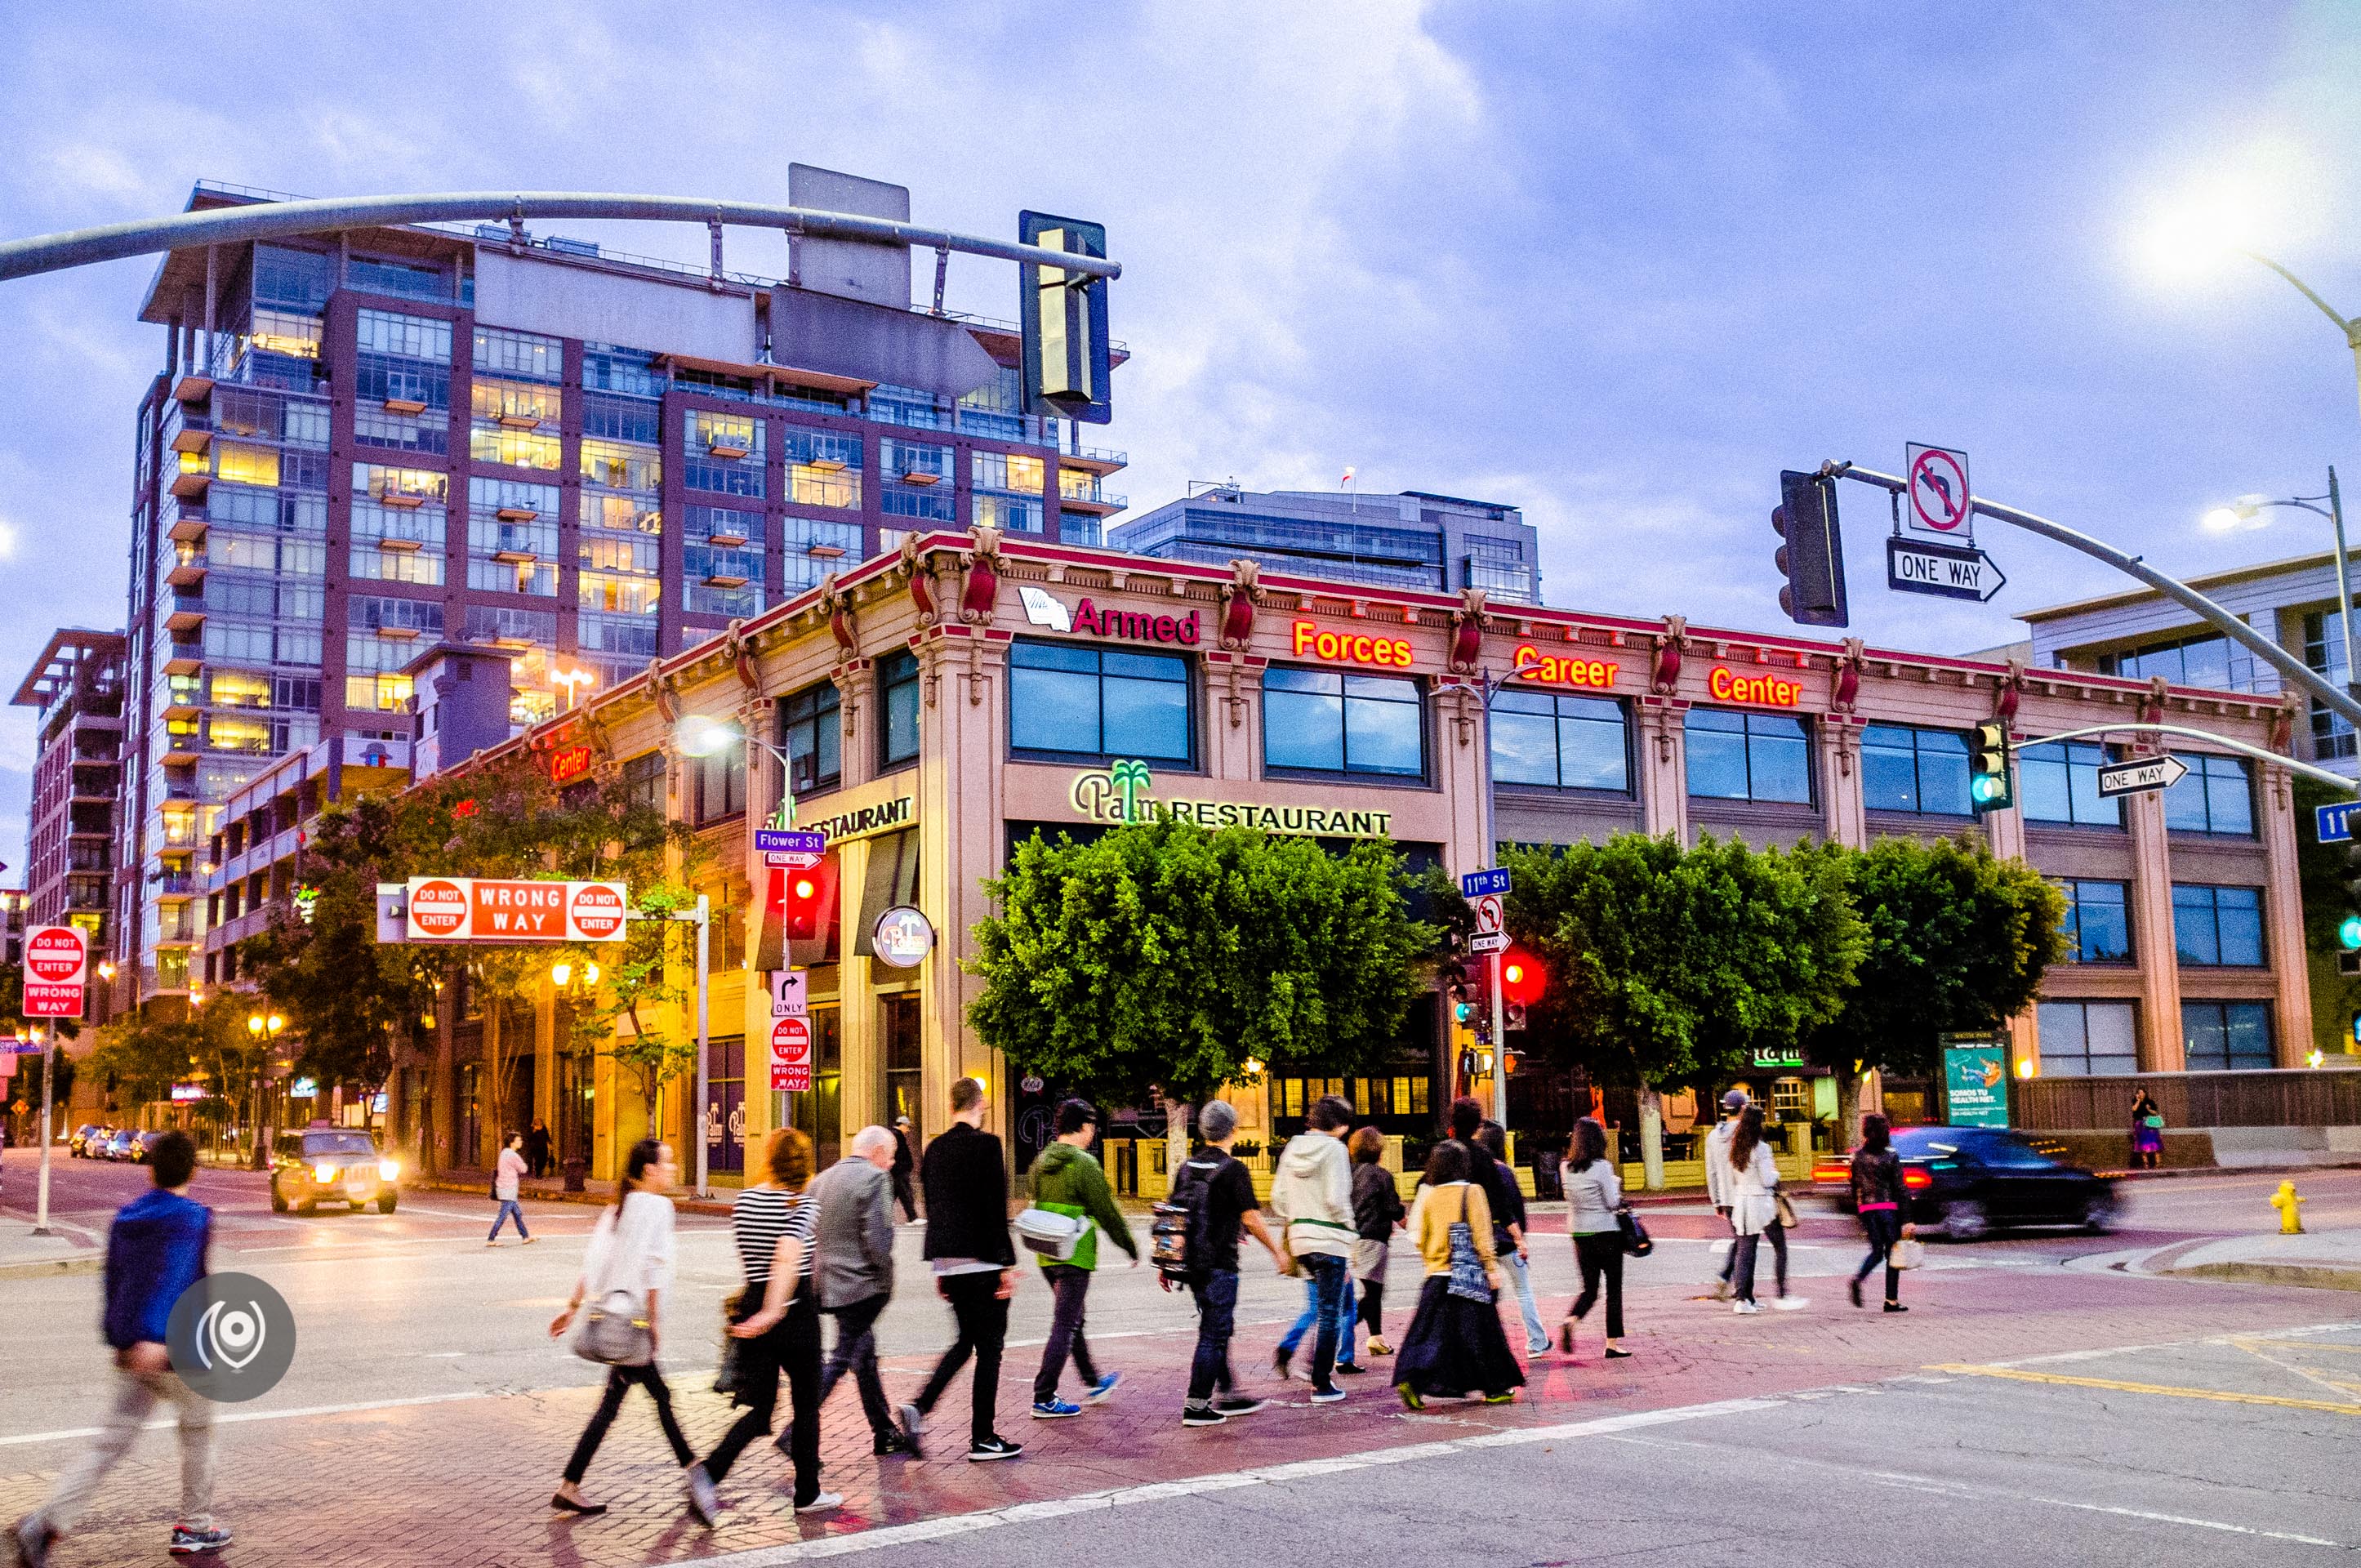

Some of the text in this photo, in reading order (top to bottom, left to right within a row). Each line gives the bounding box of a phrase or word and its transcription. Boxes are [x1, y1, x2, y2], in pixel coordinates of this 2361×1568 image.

[1902, 555, 1981, 587] ONE WAY
[1071, 597, 1802, 706] Armed Forces Career Center
[552, 746, 590, 782] Center
[2104, 766, 2164, 789] ONE WAY
[800, 797, 911, 841] STAURANT
[1171, 800, 1392, 835] RESTAURANT
[760, 834, 819, 849] Flower St
[770, 852, 805, 862] ONE WAY
[1467, 874, 1506, 894] 11th St
[420, 889, 459, 902] DO NOT
[479, 888, 560, 907] WRONG
[578, 893, 617, 906] DO NOT
[421, 915, 457, 927] ENTER
[492, 913, 546, 931] WAY
[581, 918, 614, 930] ENTER
[36, 938, 77, 948] DO NOT
[1473, 938, 1499, 949] ONE WAY
[36, 962, 74, 973] ENTER
[28, 987, 81, 999] WRONG
[37, 1001, 70, 1012] WAY
[776, 1004, 803, 1013] ONLY
[777, 1027, 804, 1035] DO NOT
[778, 1046, 803, 1055] ENTER
[773, 1067, 809, 1076] WRONG
[778, 1078, 801, 1088] WAY
